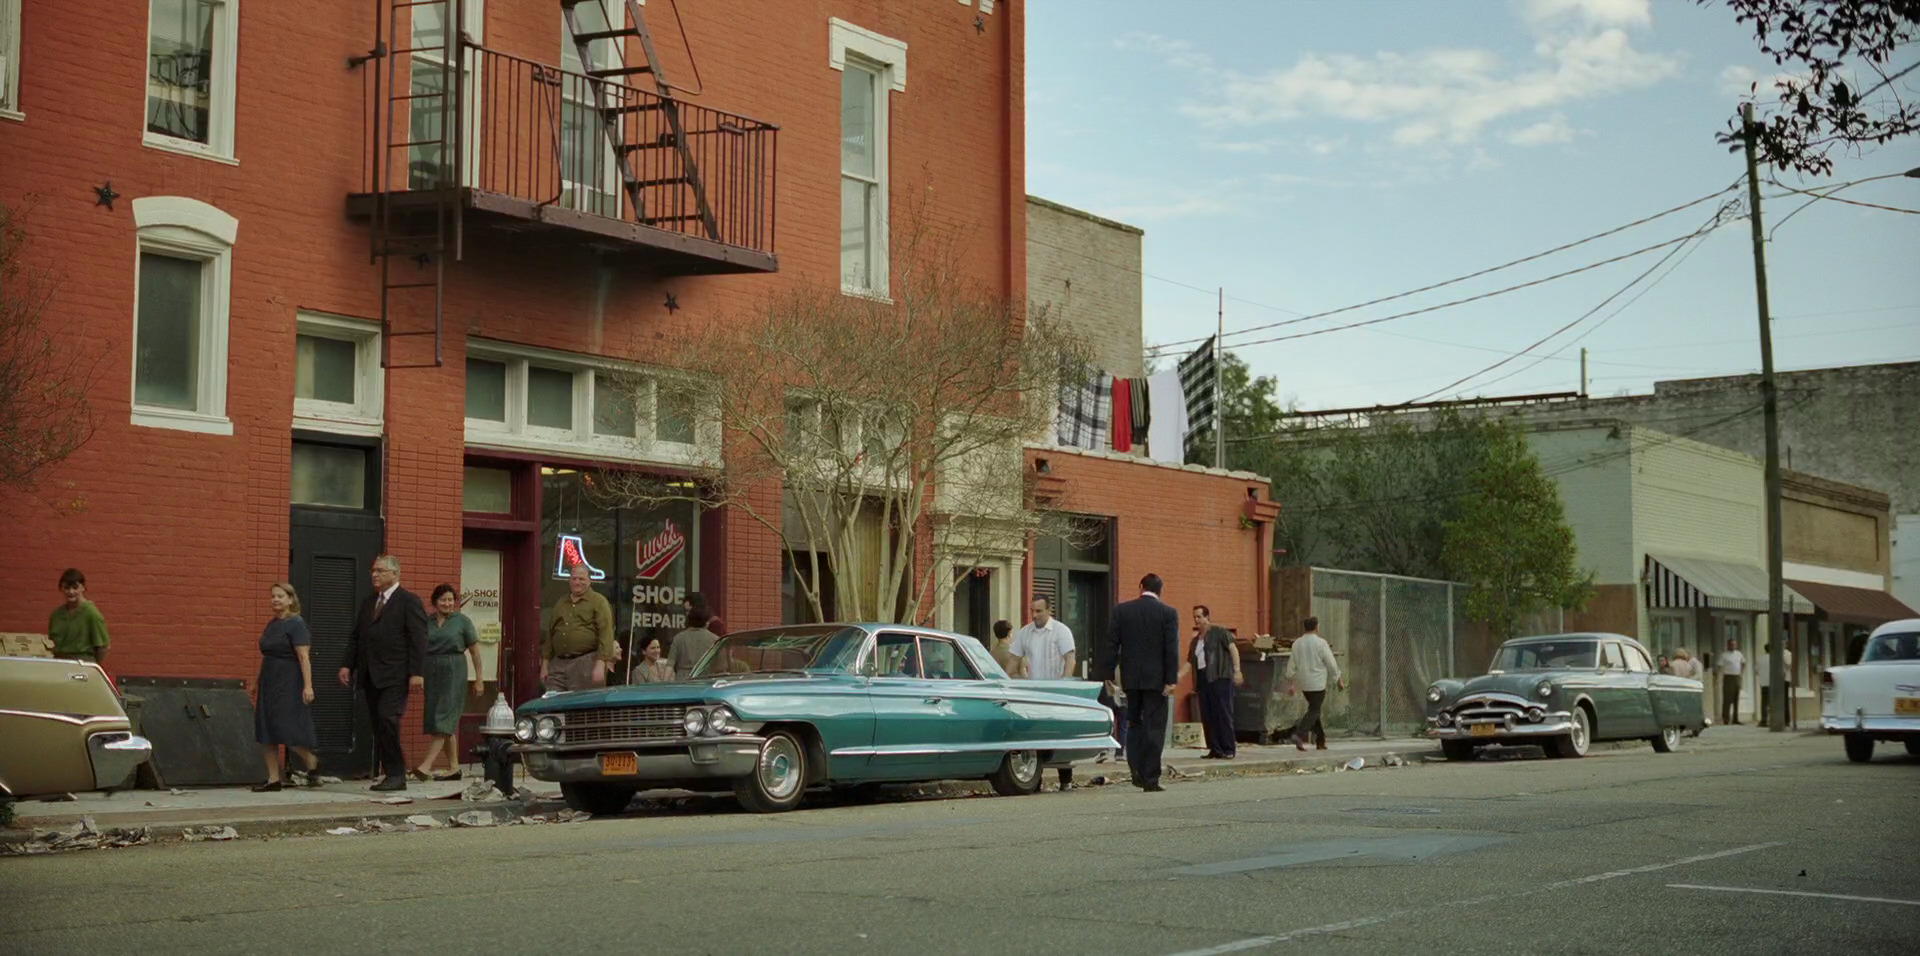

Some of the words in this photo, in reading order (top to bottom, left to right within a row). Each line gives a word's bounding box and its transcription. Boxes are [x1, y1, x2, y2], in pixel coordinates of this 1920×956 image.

[636, 517, 685, 570] Luca's
[473, 589, 498, 598] SHOE
[632, 585, 685, 605] SHOE
[473, 600, 498, 608] REPAIR
[632, 612, 686, 629] REPAIR
